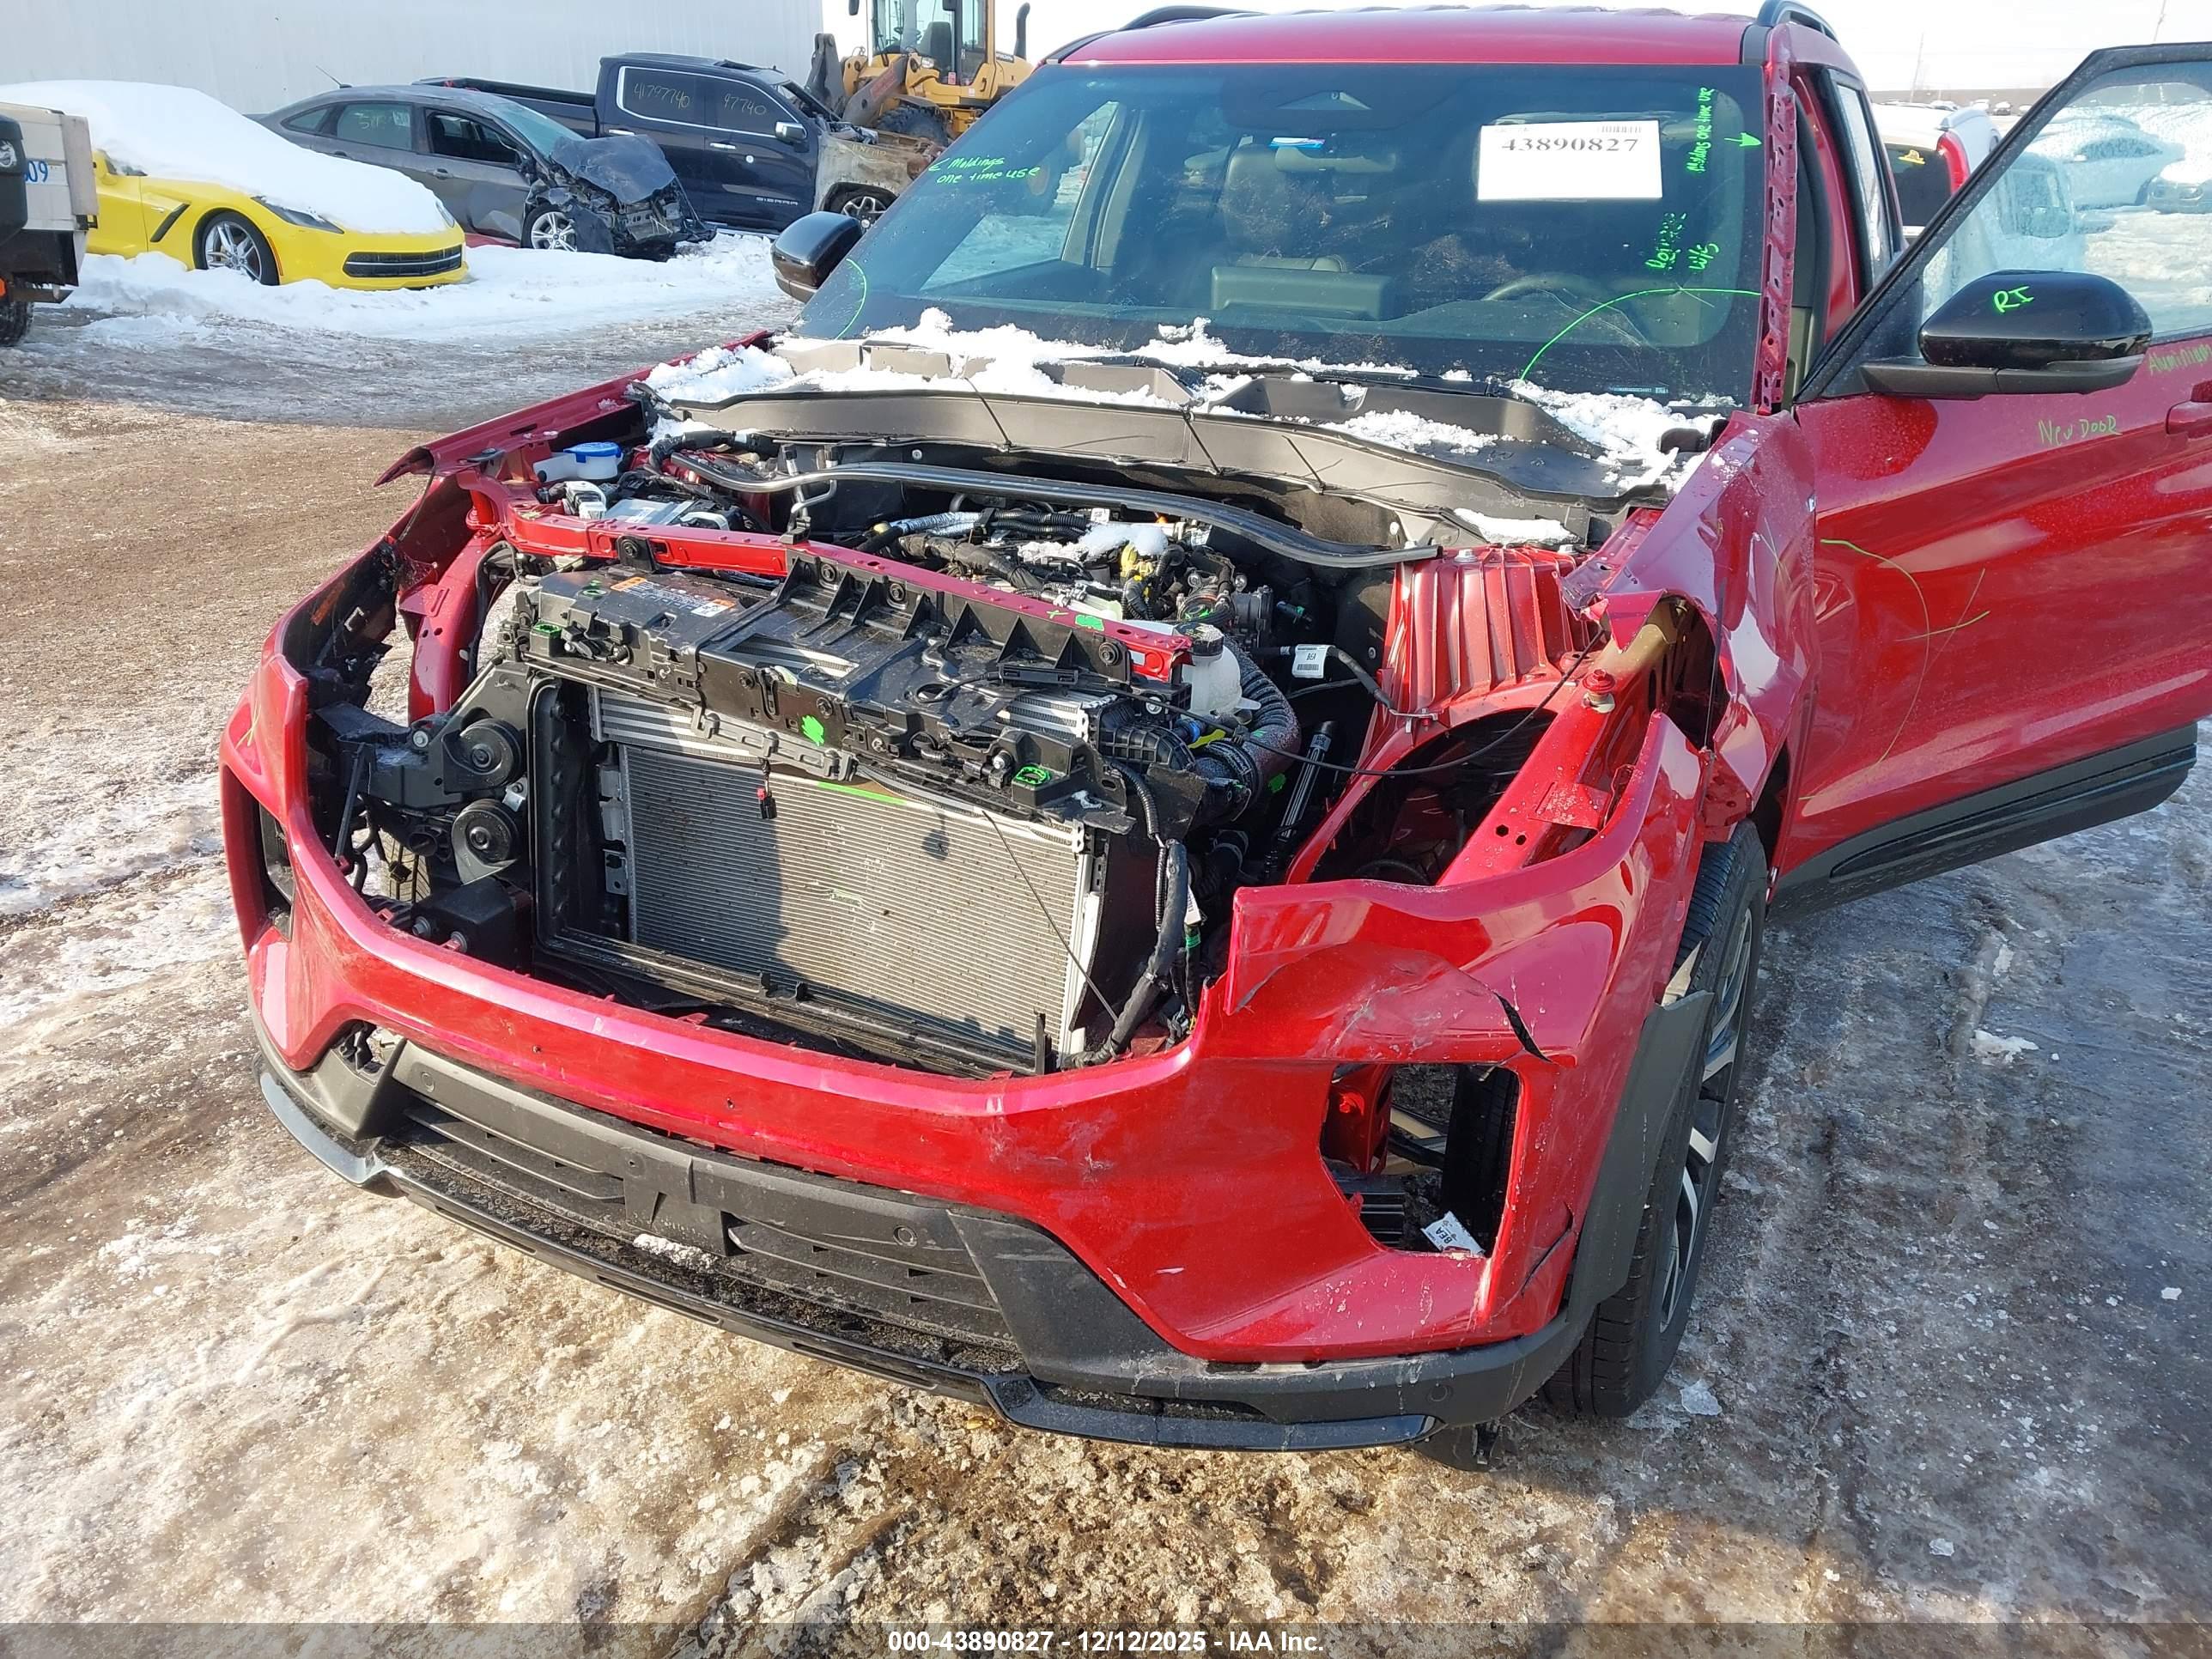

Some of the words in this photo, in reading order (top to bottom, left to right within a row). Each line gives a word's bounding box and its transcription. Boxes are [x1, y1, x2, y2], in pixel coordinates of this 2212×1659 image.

[1501, 137, 1639, 152] 43890827
[936, 173, 963, 184] one
[1006, 167, 1041, 179] use
